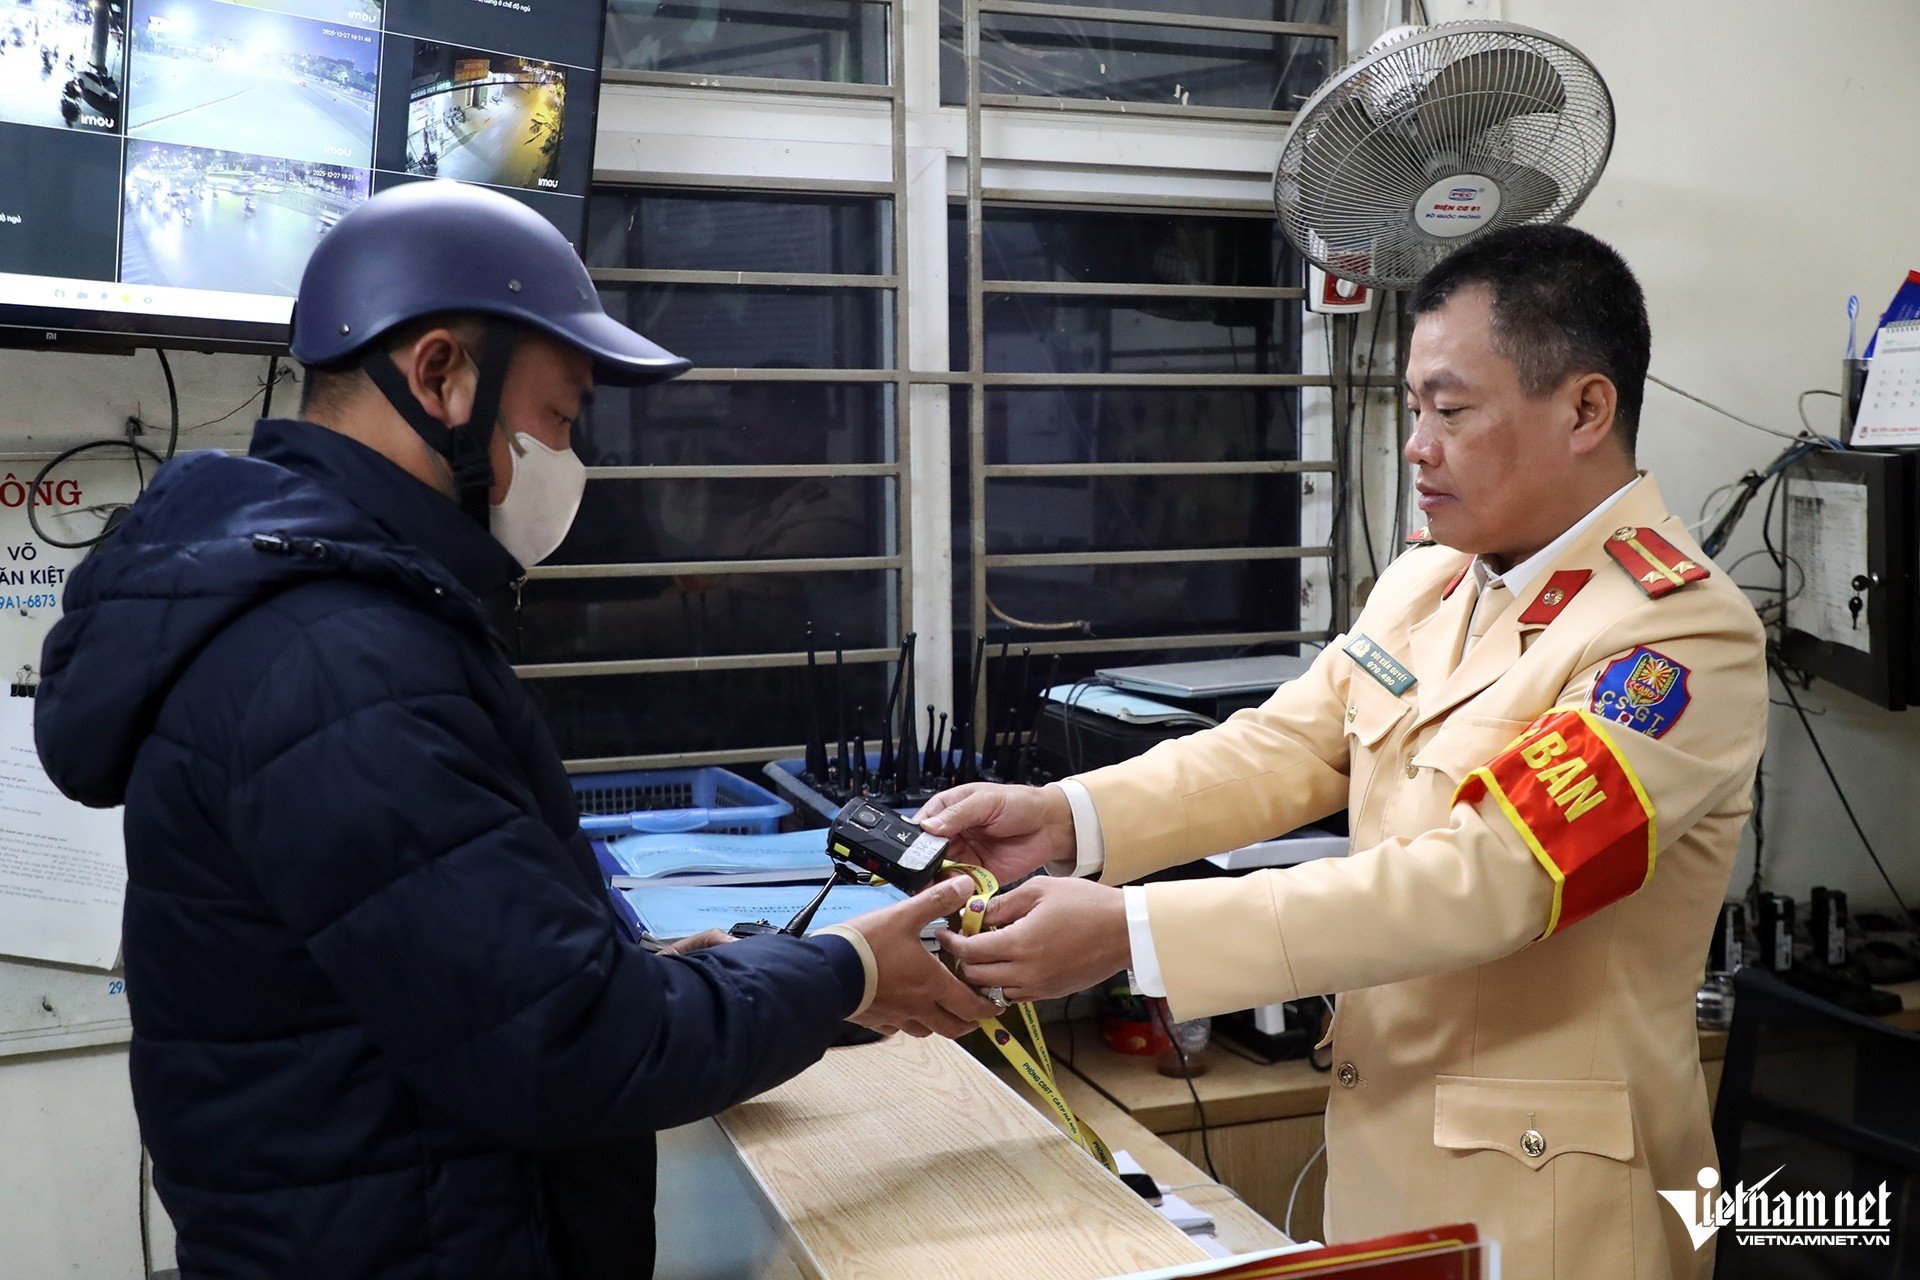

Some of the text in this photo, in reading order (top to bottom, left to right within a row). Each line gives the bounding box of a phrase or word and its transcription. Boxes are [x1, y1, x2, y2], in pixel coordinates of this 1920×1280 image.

[0, 472, 82, 507] ÔNG
[7, 542, 37, 561] VÕ
[30, 565, 65, 587] KIỆT
[1601, 690, 1664, 730] CSGT
[1520, 730, 1607, 823] BAN
[1023, 1062, 1041, 1083] PHÒNG
[1038, 1081, 1052, 1095] CSGT
[1053, 1097, 1066, 1114] CATP
